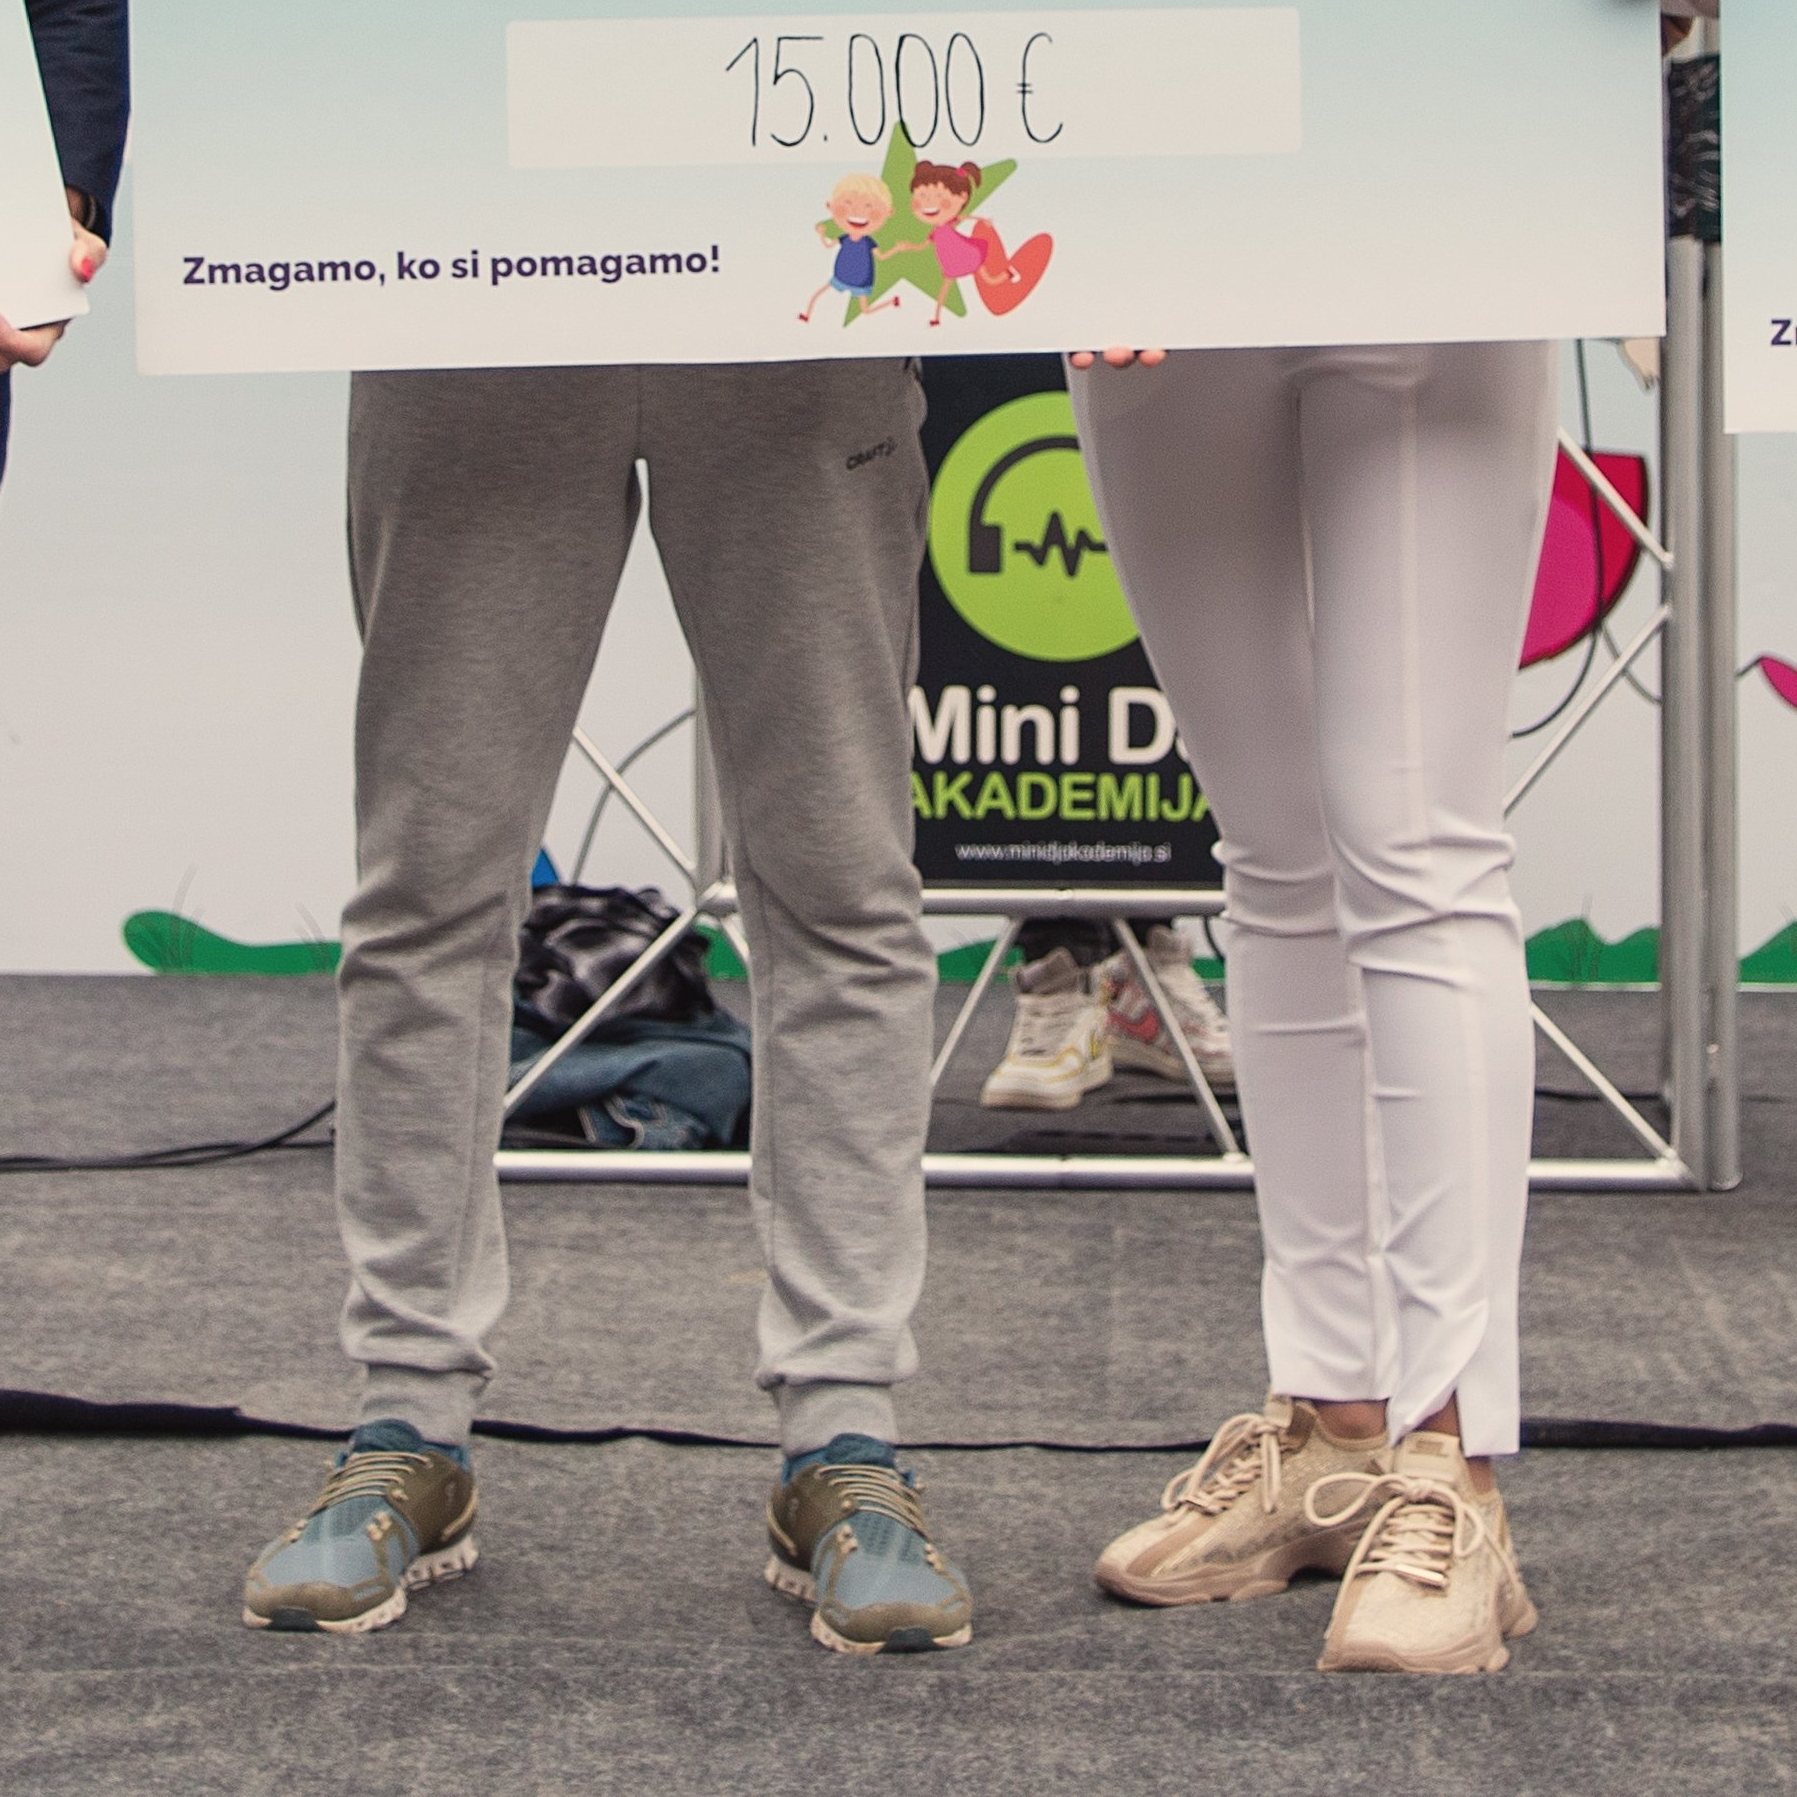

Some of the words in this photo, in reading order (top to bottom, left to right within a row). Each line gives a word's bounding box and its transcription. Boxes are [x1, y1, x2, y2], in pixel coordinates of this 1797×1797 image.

[725, 32, 986, 149] 15.000
[1016, 32, 1064, 144] €
[182, 256, 387, 292] Zmagamo,
[396, 250, 442, 282] ko
[450, 247, 481, 281] si
[490, 243, 721, 288] pomagamo!
[906, 684, 1081, 766] Mini
[1108, 686, 1190, 765] D
